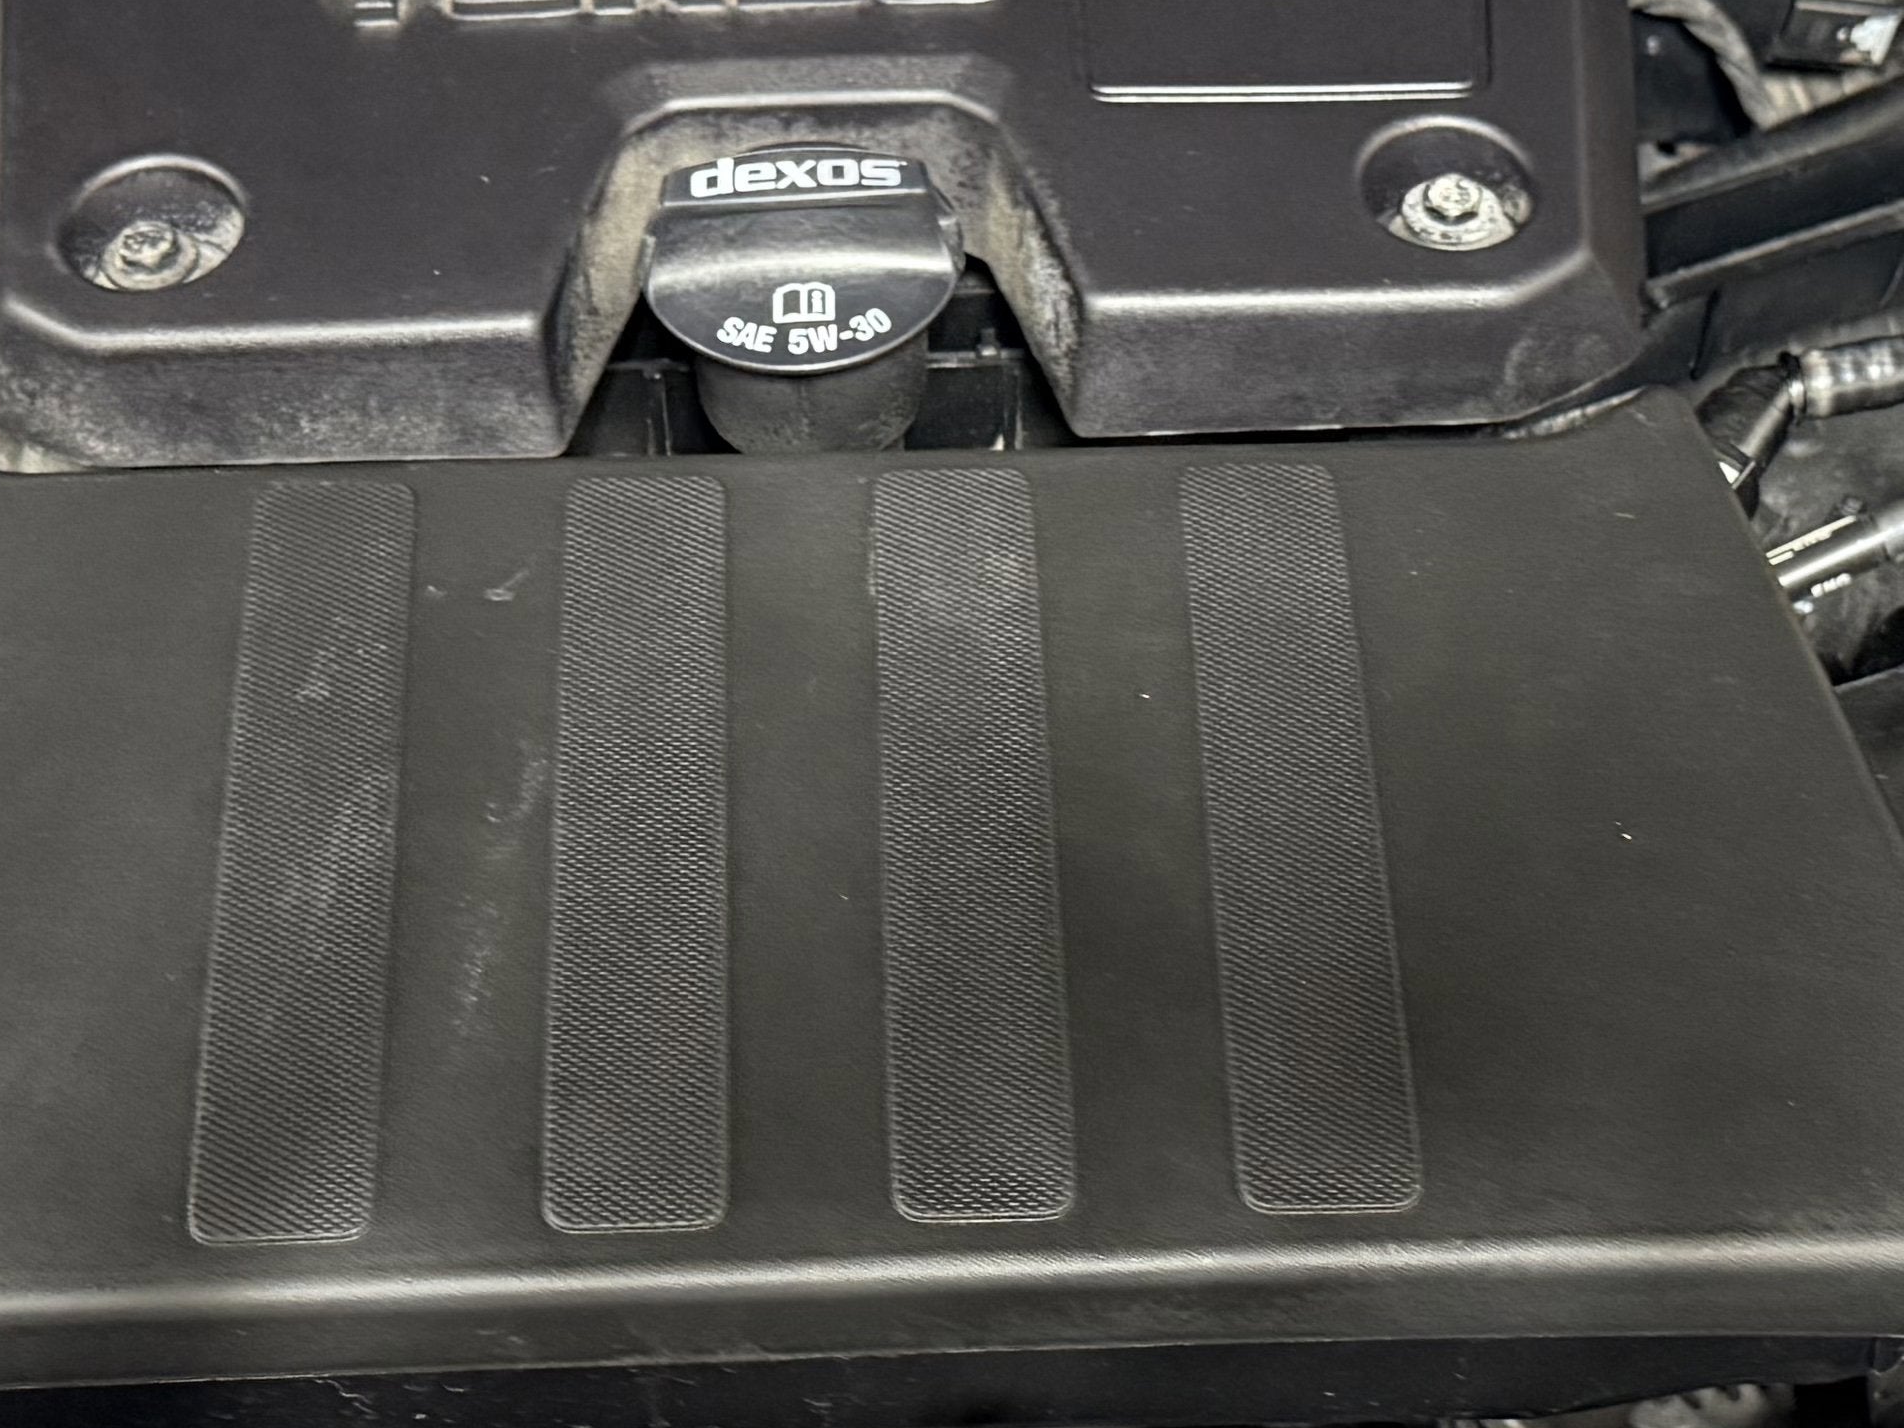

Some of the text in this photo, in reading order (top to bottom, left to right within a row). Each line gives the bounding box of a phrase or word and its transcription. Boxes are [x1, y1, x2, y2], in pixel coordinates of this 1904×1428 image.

[690, 157, 903, 198] dexos
[716, 307, 892, 355] SAE 5W-30
